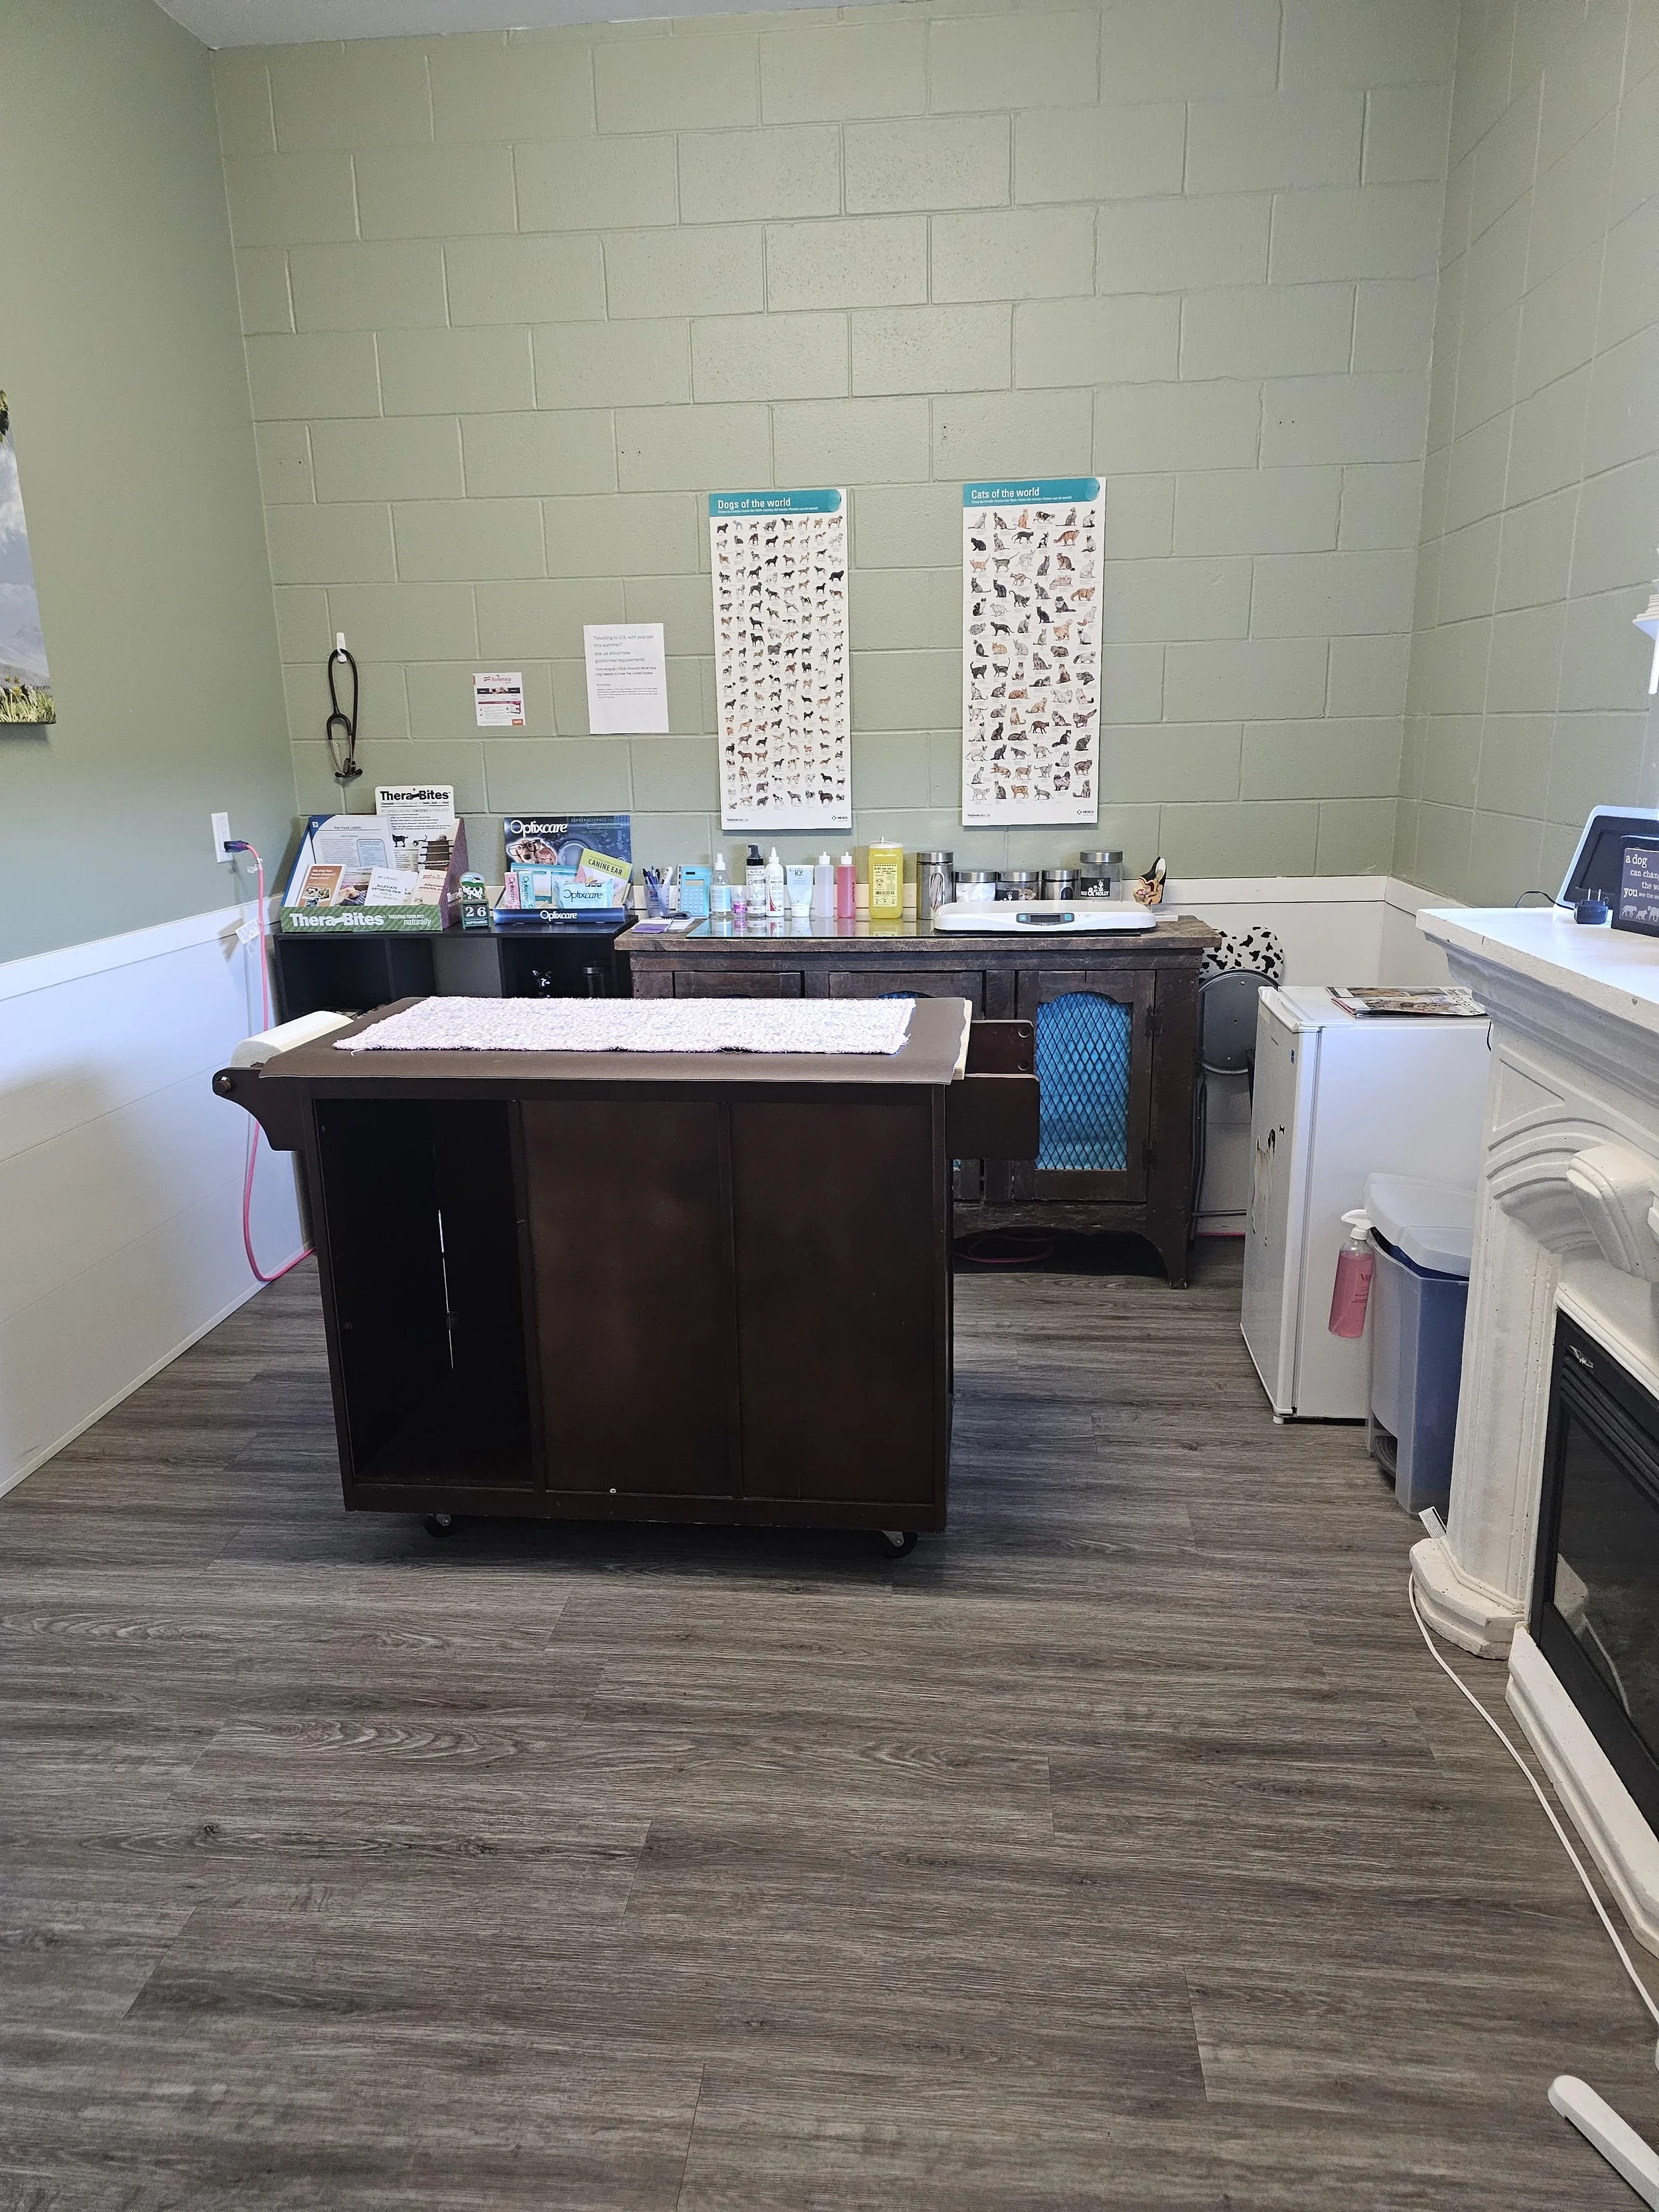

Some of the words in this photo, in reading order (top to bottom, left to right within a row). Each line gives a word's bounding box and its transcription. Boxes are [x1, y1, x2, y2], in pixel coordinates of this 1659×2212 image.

[971, 490, 989, 499] Cats
[991, 488, 1000, 498] of
[1001, 488, 1015, 498] the
[1016, 486, 1040, 496] world
[717, 500, 739, 510] Dogs
[741, 499, 750, 508] of
[751, 498, 764, 508] the
[766, 497, 791, 507] world
[510, 820, 569, 838] Optixcare
[588, 859, 611, 871] CANINE
[611, 866, 623, 875] EAR
[1625, 855, 1631, 863] a
[1632, 854, 1648, 868] dog
[563, 889, 603, 903] Optixcare
[1088, 887, 1095, 897] &
[1624, 887, 1638, 898] you
[403, 918, 431, 926] naturally
[540, 910, 577, 922] Optixcare
